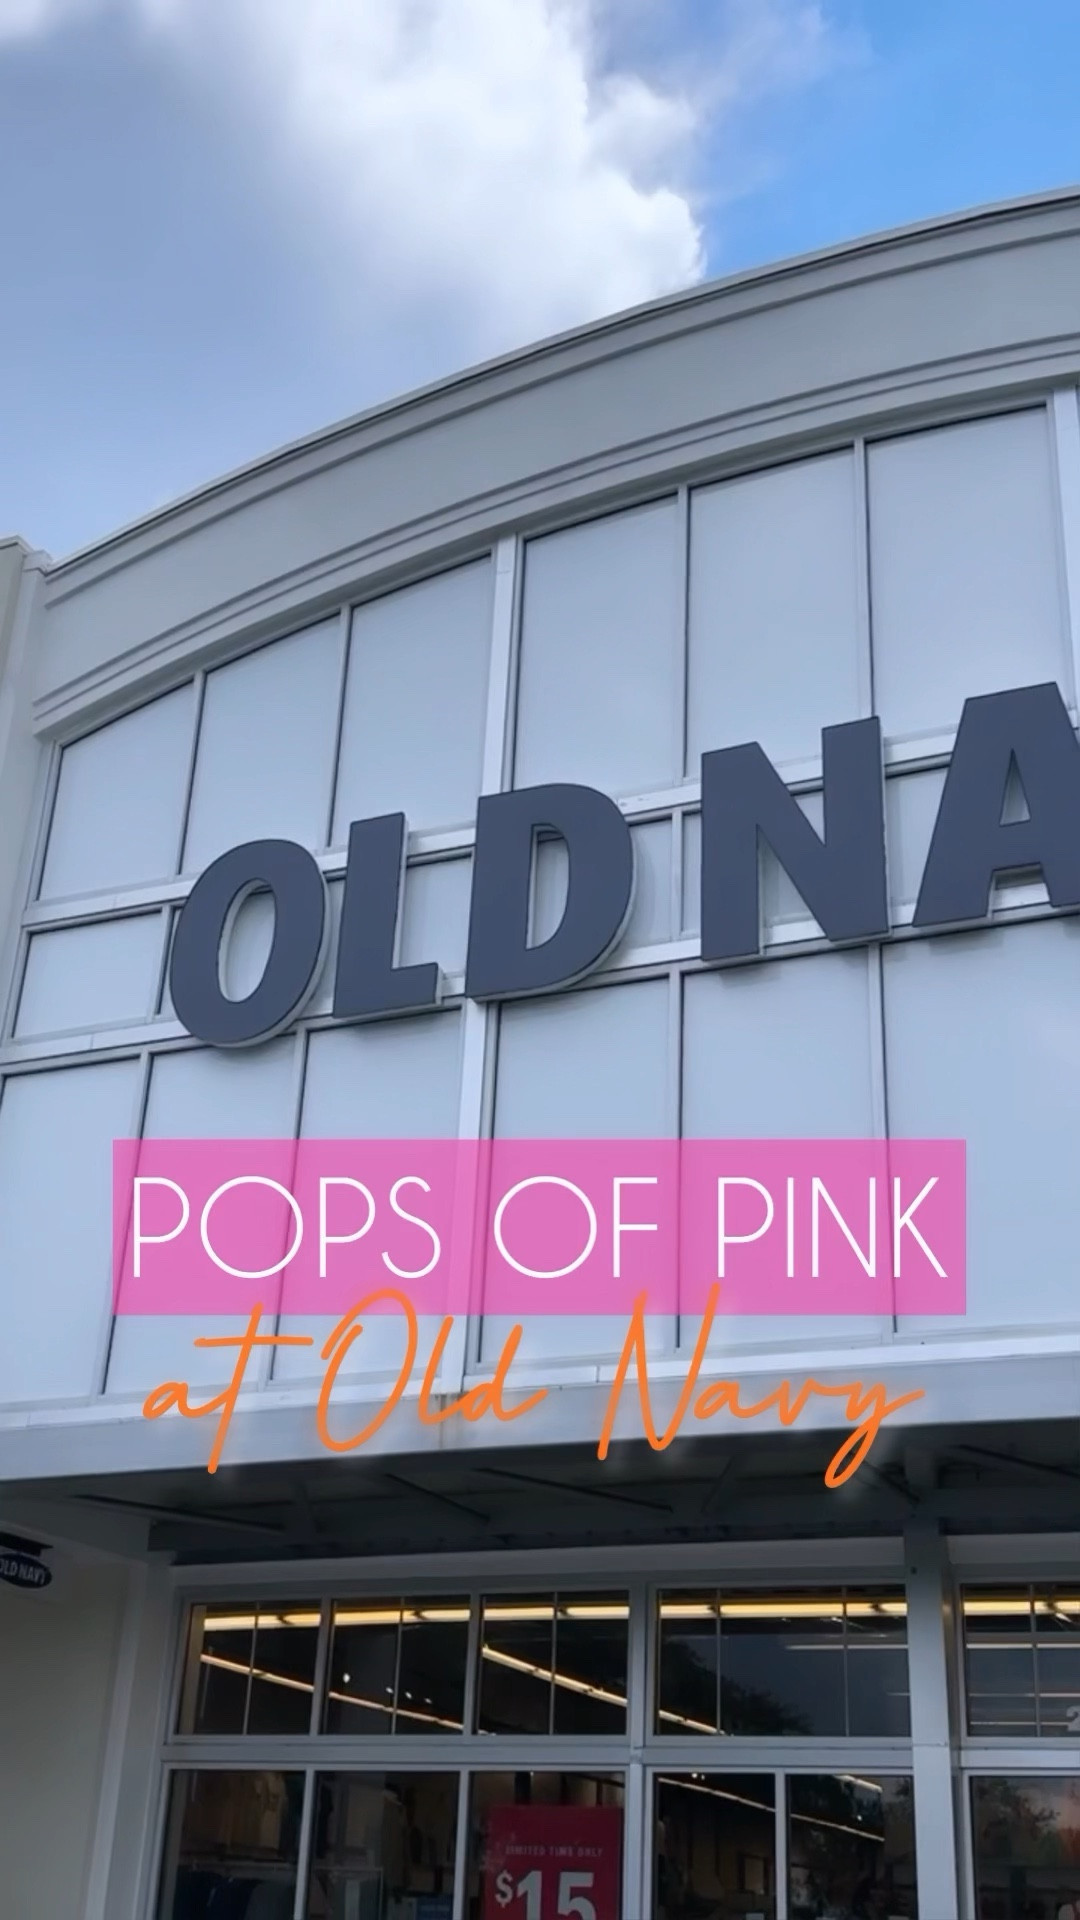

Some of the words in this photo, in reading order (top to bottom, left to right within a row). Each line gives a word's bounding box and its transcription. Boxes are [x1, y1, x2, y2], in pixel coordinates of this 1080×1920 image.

[169, 782, 636, 1048] OLD
[18, 1563, 46, 1585] NAVY
[506, 1845, 546, 1856] LIMITED
[550, 1846, 574, 1857] TIME
[577, 1847, 603, 1857] ONLY
